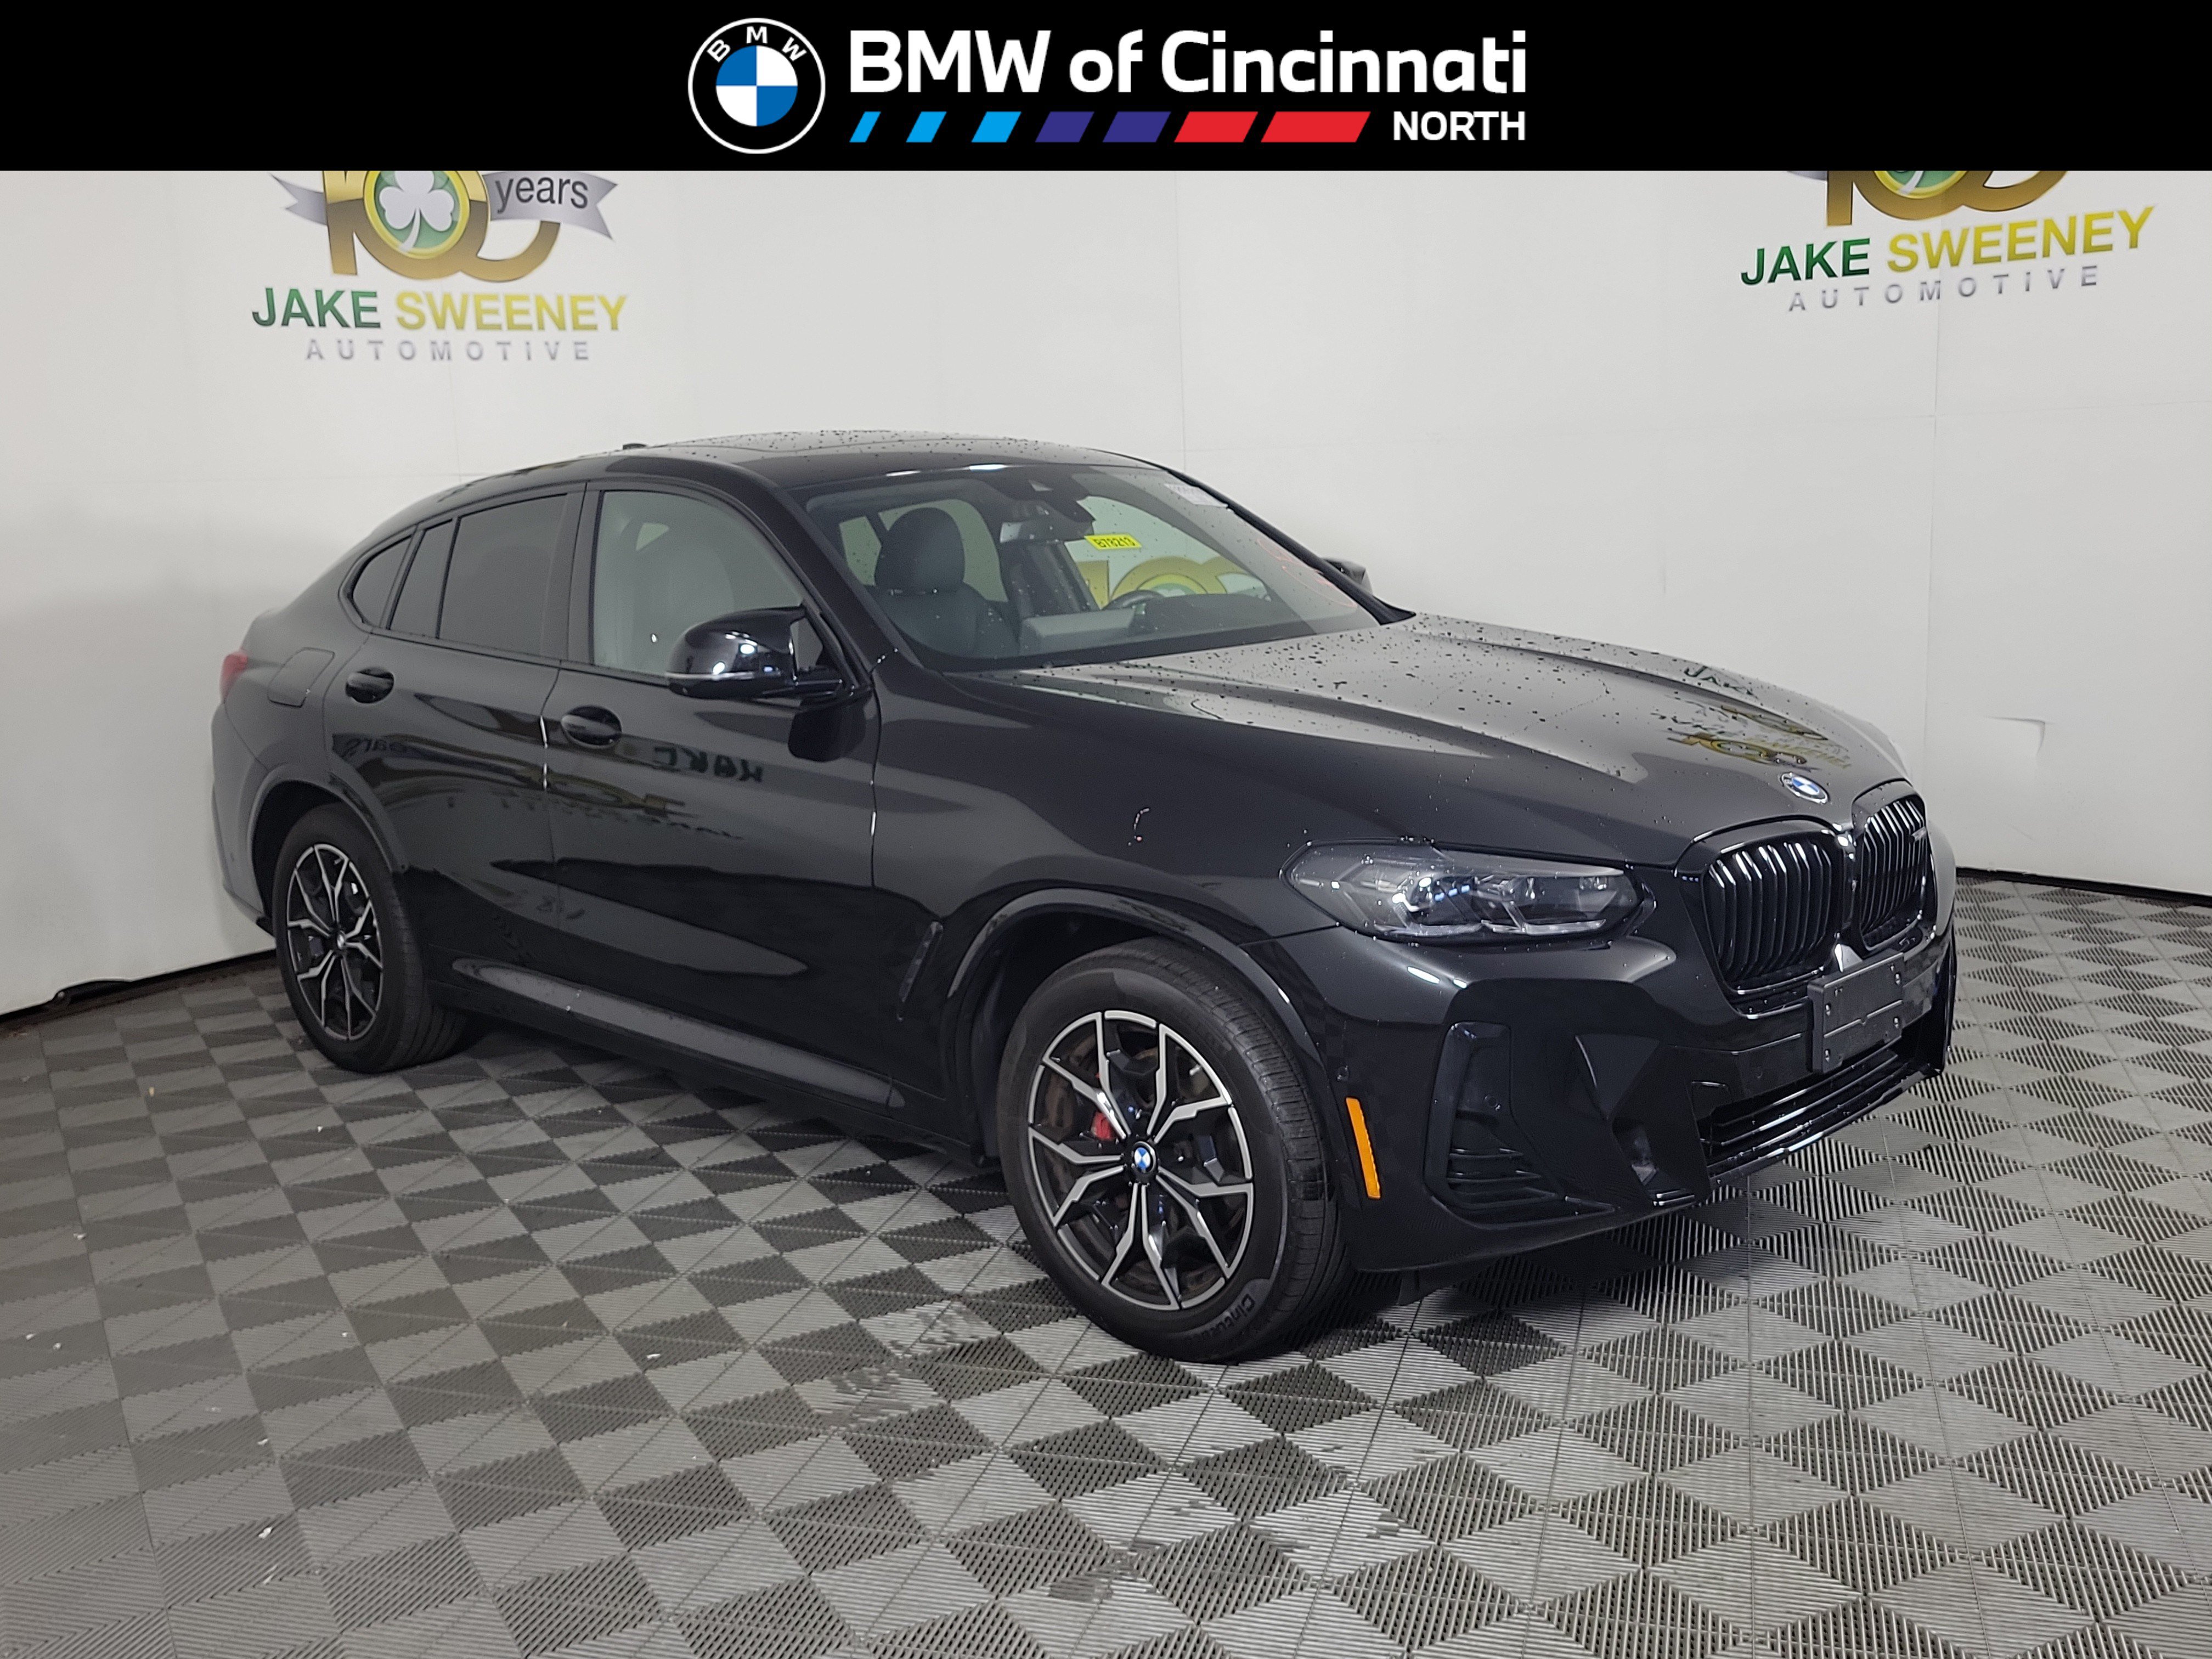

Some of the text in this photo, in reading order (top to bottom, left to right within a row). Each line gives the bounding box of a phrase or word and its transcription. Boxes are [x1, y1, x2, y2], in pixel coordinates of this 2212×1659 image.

[495, 176, 589, 214] years
[1740, 205, 2157, 286] JAKE SWEENEY
[251, 286, 628, 332] JAKE SWEENEY
[1788, 264, 2099, 313] AUTOMOTIVE
[305, 339, 590, 362] AUTOMOTIVE
